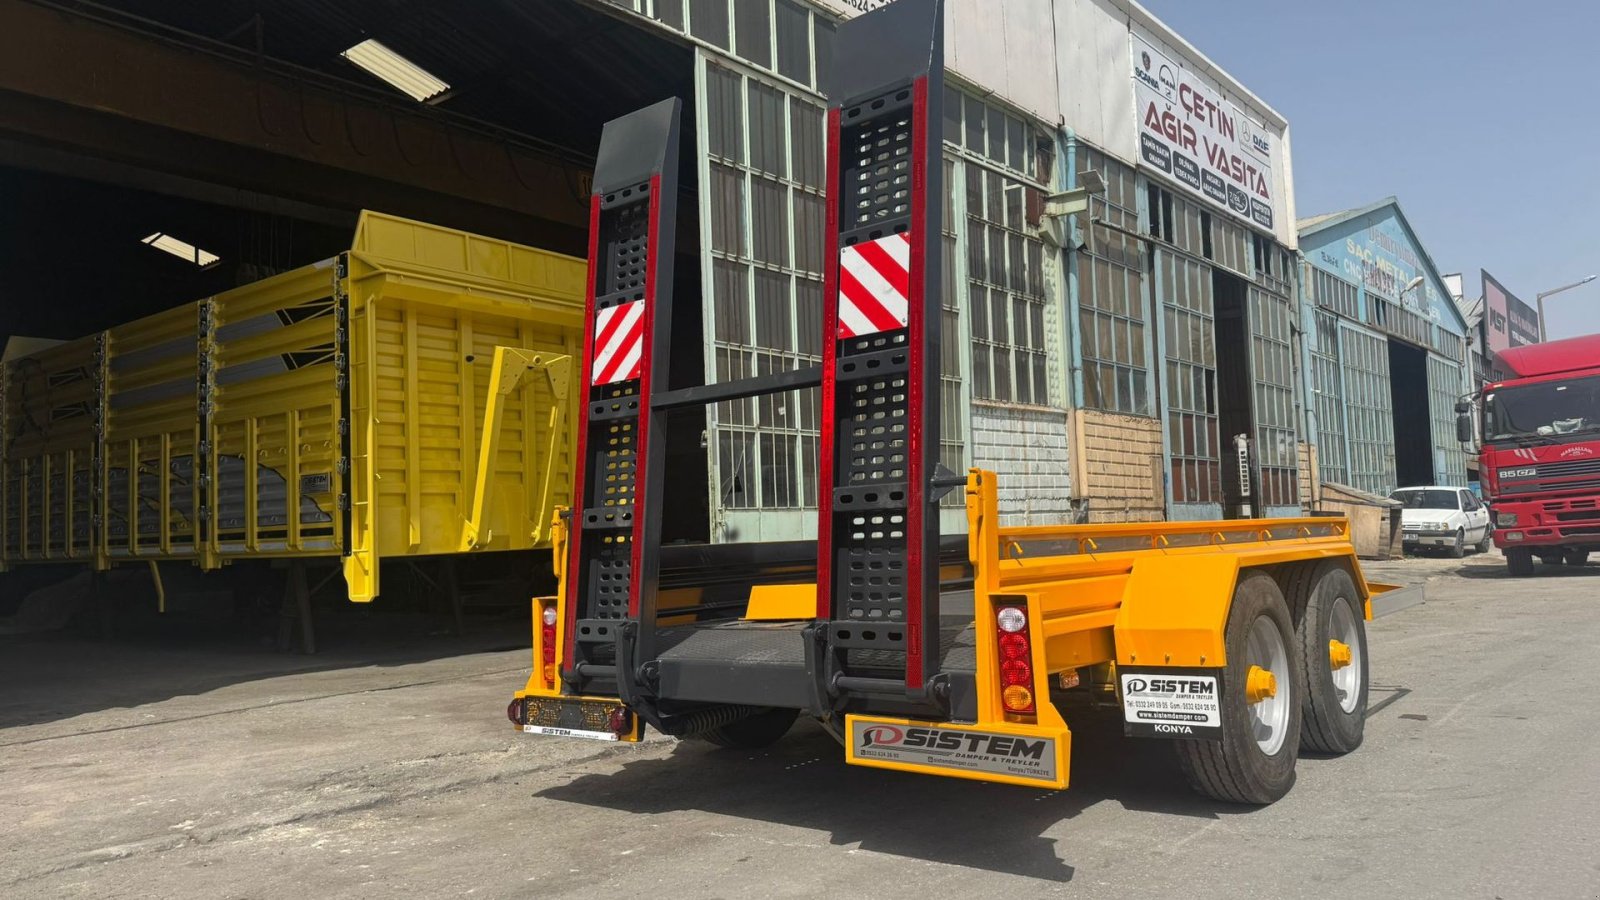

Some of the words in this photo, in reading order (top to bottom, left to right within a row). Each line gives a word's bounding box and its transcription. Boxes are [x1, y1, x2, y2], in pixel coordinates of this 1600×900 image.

[1135, 67, 1160, 91] SCANIA
[1160, 76, 1176, 91] MAN
[1179, 83, 1235, 142] ÇETİN
[1145, 101, 1198, 157] AĞIR
[1203, 135, 1269, 199] VASITA
[1253, 134, 1269, 151] DAF
[1139, 712, 1206, 721] www.sistemdamper.com
[1155, 725, 1193, 734] KONYA
[955, 753, 990, 761] DAMPER
[1000, 757, 1041, 767] TREYLER
